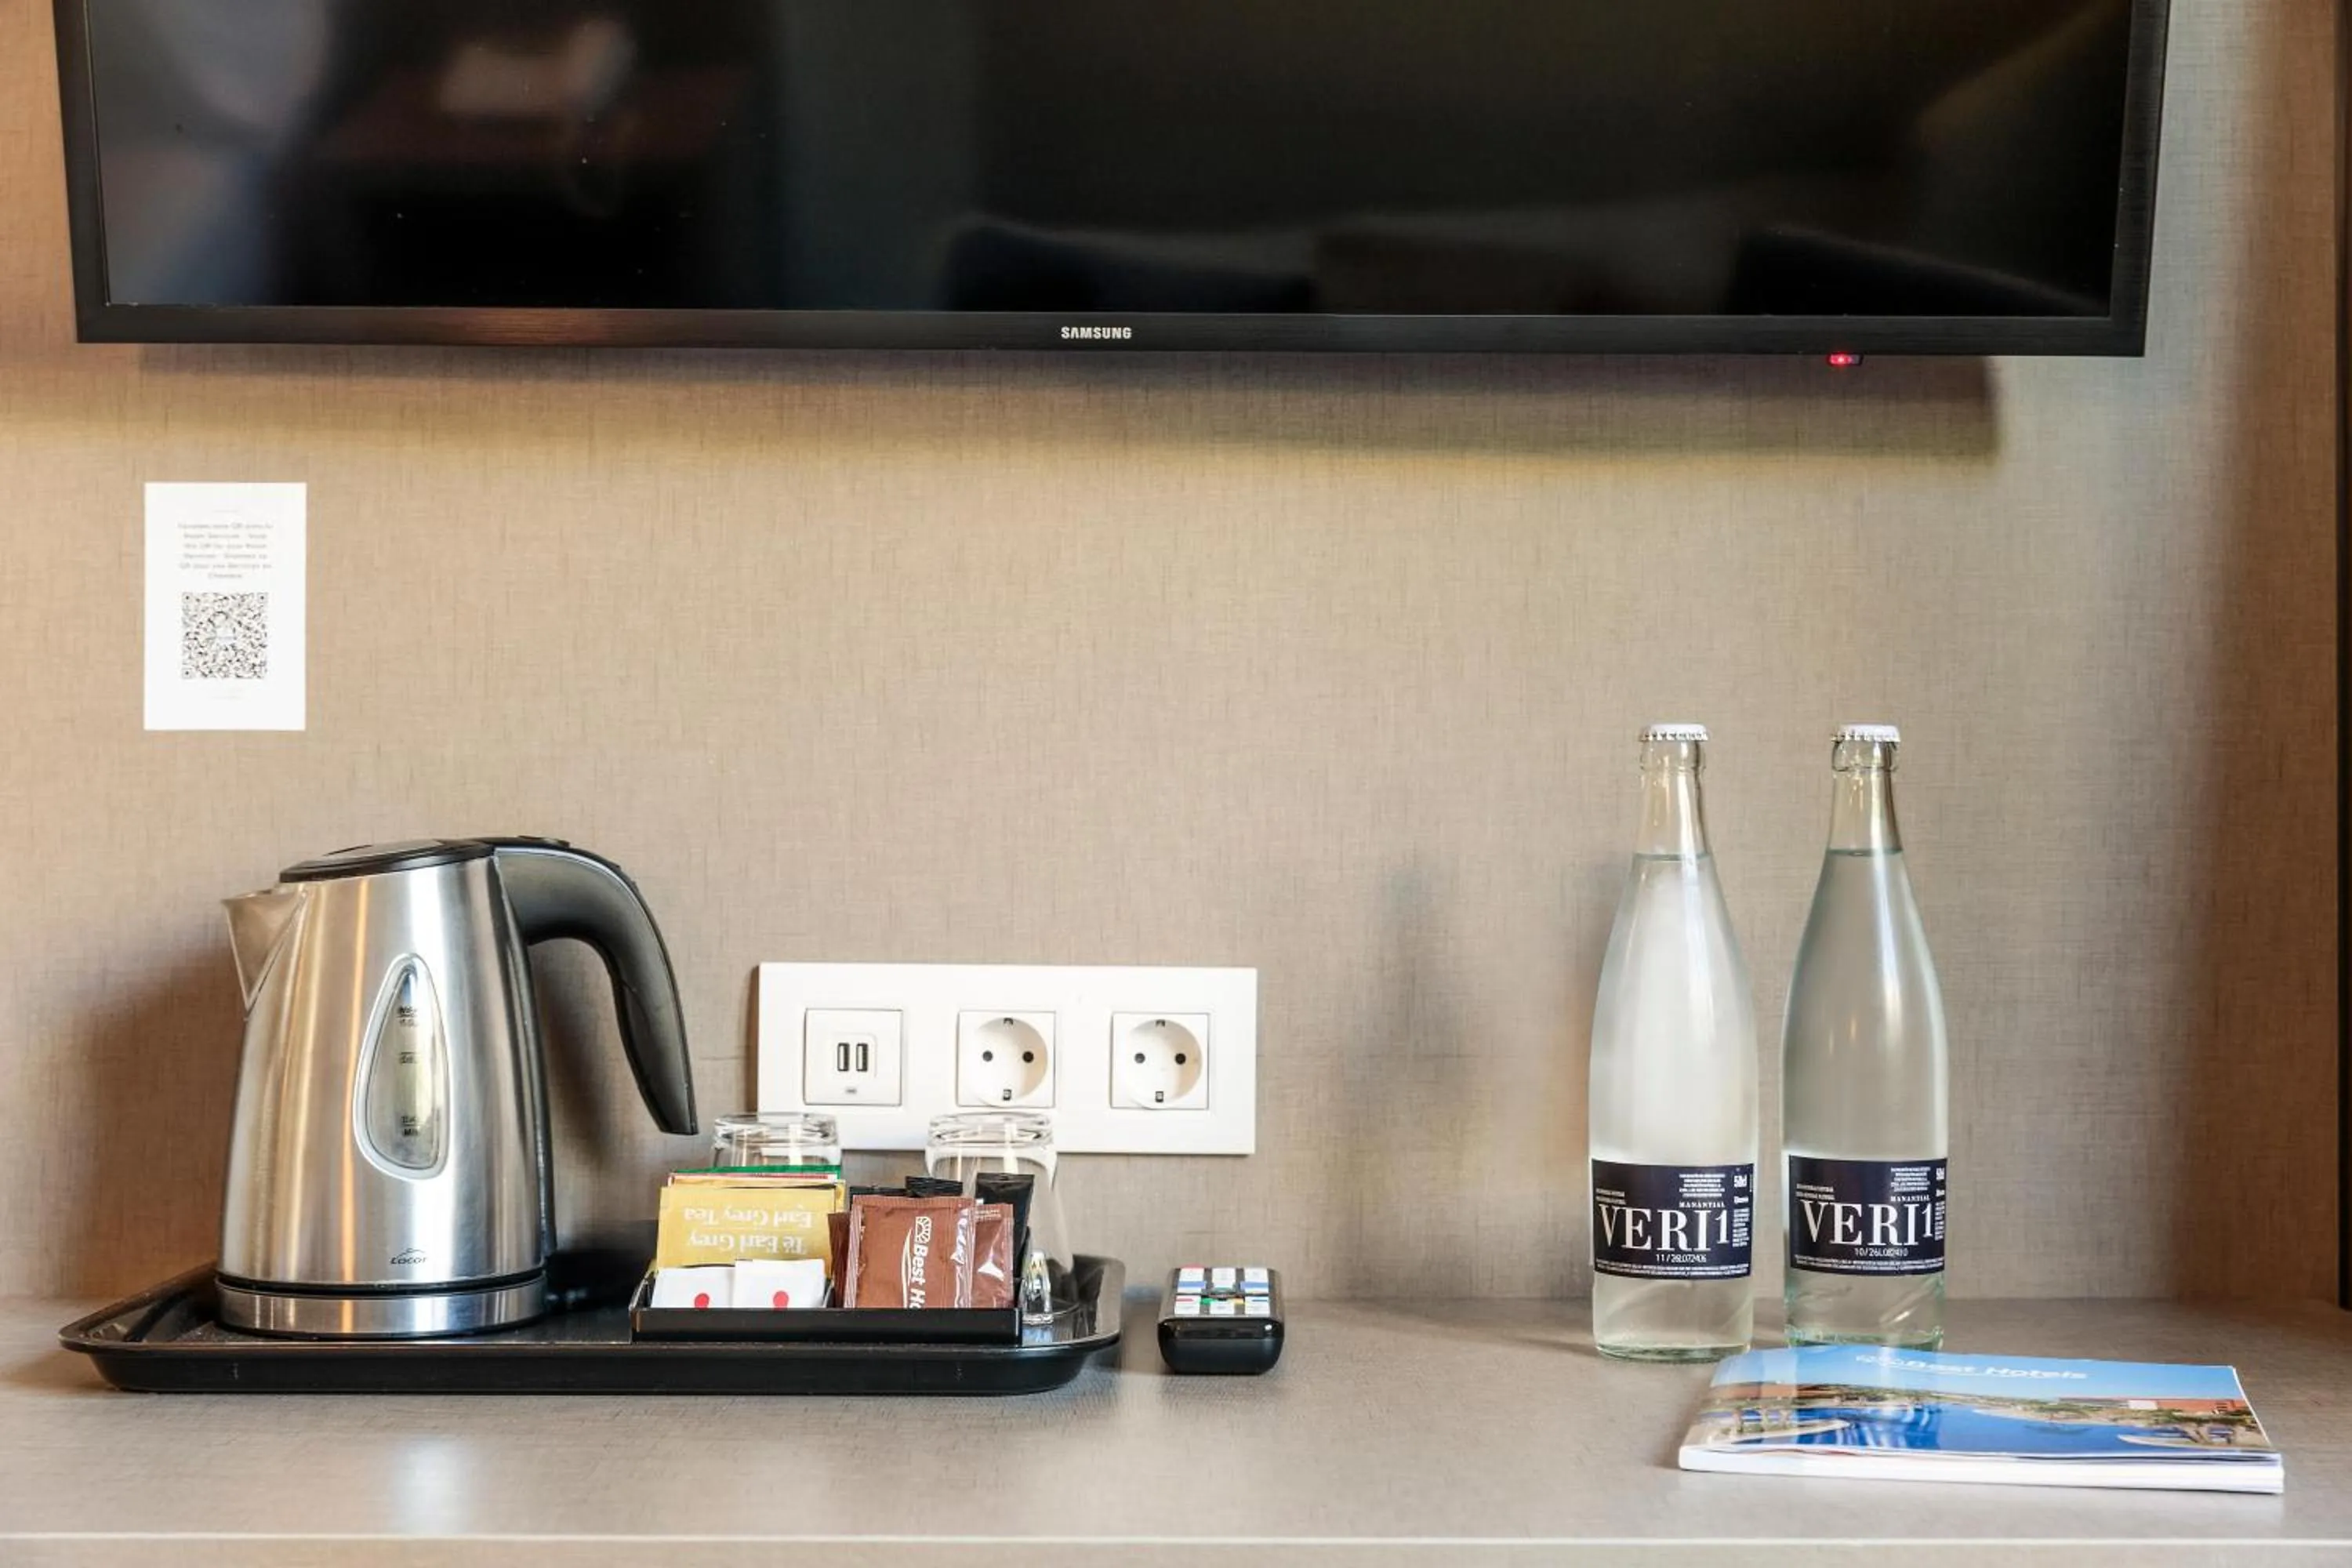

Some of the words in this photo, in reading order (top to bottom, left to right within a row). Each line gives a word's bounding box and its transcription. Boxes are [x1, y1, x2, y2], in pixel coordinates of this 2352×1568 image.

[1061, 326, 1132, 339] SAMSUNG
[684, 1207, 719, 1225] Tea
[724, 1205, 768, 1226] Grey
[774, 1206, 813, 1228] Earl
[689, 1229, 735, 1252] Grey
[739, 1233, 779, 1254] Earl
[911, 1243, 928, 1286] Best
